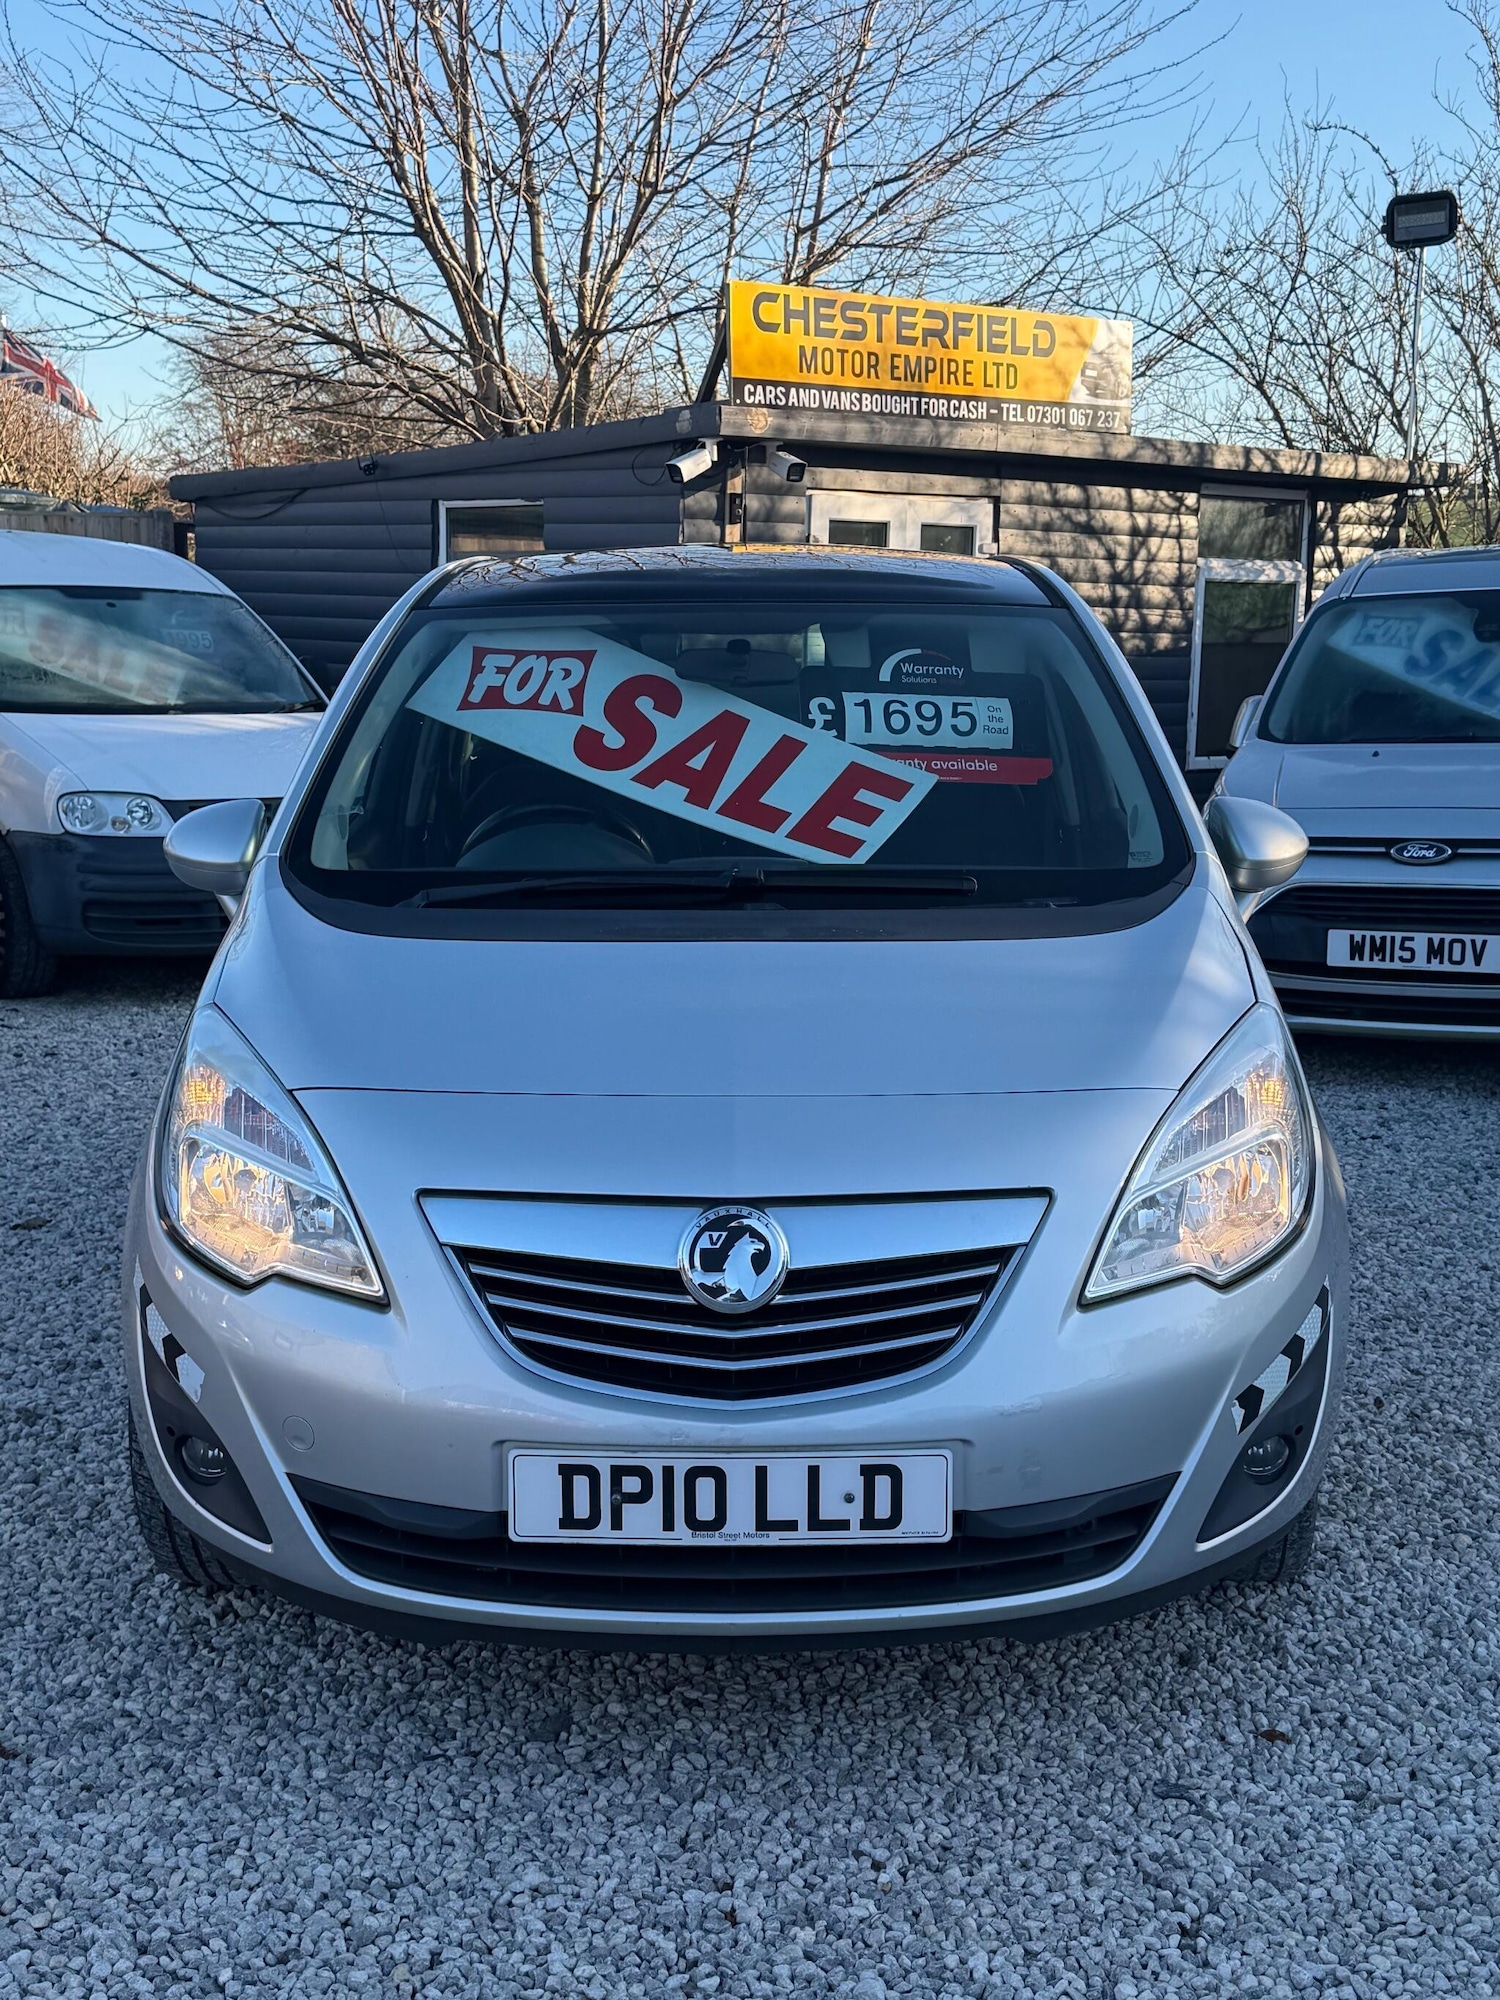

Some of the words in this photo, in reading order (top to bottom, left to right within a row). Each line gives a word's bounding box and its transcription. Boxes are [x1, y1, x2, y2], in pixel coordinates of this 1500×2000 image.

[752, 291, 1057, 358] CHESTERFIELD
[798, 345, 880, 379] MOTOR
[890, 352, 974, 387] EMPIRE
[983, 360, 1018, 390] LTD
[743, 383, 786, 406] CARS
[788, 387, 820, 408] AND
[821, 390, 863, 411] VANS
[862, 392, 920, 415] BOUGHT
[920, 397, 948, 417] FOR
[950, 399, 987, 420] CASH
[1001, 403, 1025, 423] TEL
[1027, 405, 1066, 425] 07301
[1069, 408, 1093, 427] 067
[1097, 410, 1121, 429] 237
[1356, 618, 1419, 648] FOR
[900, 662, 965, 679] Warranty
[901, 674, 937, 684] Solutions
[467, 653, 587, 713] FOR
[808, 697, 837, 737] £
[853, 698, 978, 738] 1695
[987, 705, 1002, 713] On
[987, 714, 1004, 724] the
[982, 725, 1009, 735] Road
[573, 674, 915, 859] SALE
[931, 758, 998, 772] available
[1403, 843, 1437, 858] Ford
[1349, 933, 1416, 964] WM15
[1426, 937, 1488, 967] MOV
[695, 1208, 770, 1229] VAUXHALL
[708, 1233, 723, 1247] V
[557, 1463, 728, 1532] DP10
[755, 1463, 903, 1532] LLD
[691, 1531, 716, 1539] Bristol
[718, 1531, 741, 1539] Street
[743, 1531, 770, 1539] Motors
